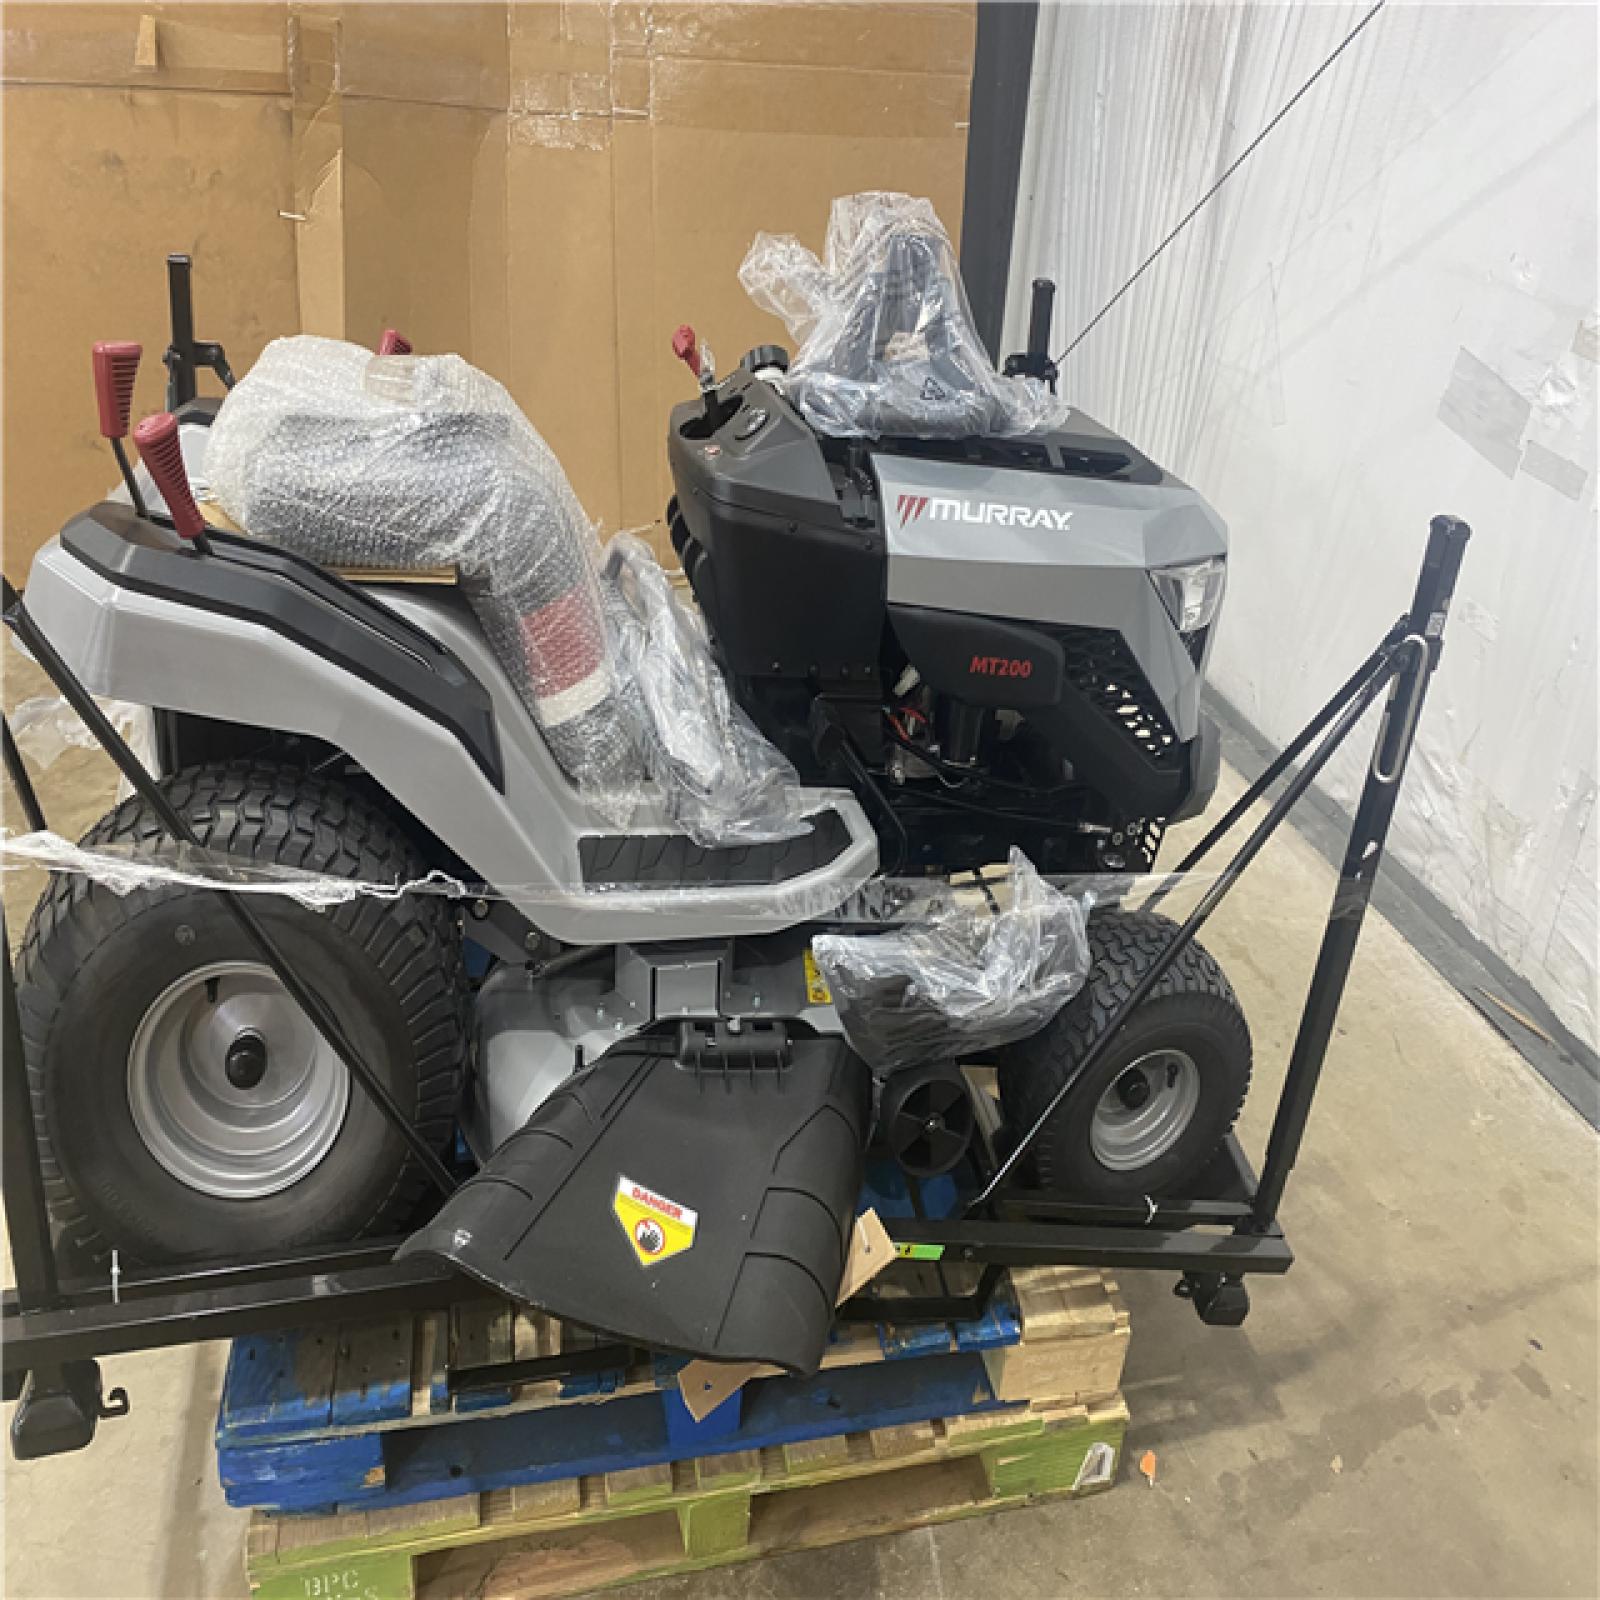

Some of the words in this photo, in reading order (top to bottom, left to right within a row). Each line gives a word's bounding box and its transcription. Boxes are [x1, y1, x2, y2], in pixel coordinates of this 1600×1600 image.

[929, 497, 1073, 530] MURRAY
[969, 655, 1033, 678] MT200
[632, 1187, 683, 1219] DANGER
